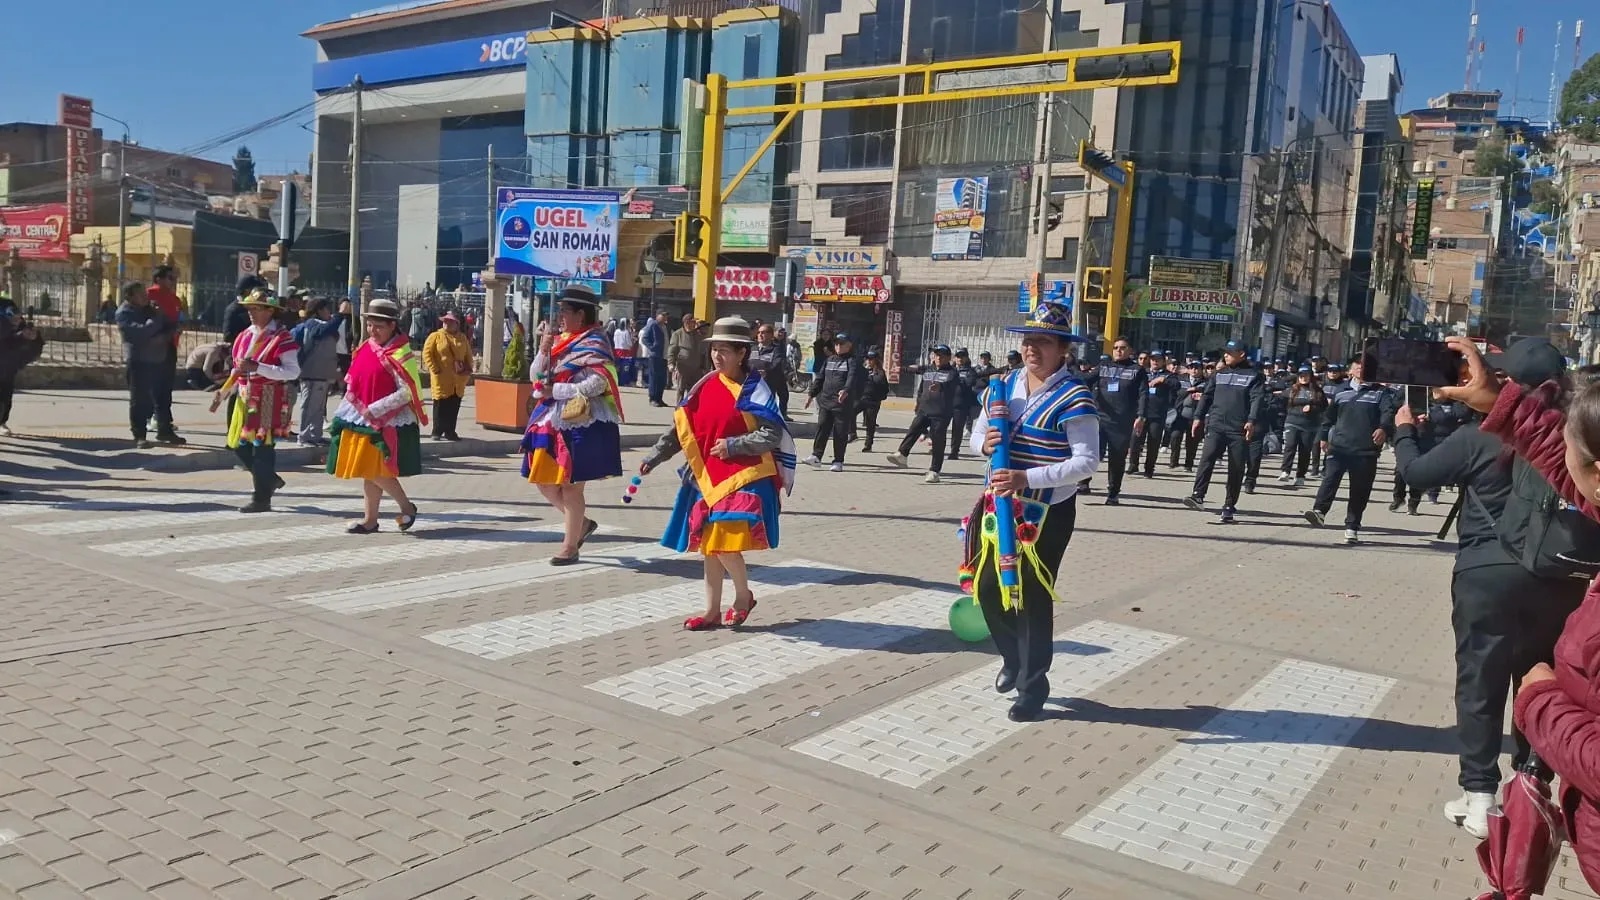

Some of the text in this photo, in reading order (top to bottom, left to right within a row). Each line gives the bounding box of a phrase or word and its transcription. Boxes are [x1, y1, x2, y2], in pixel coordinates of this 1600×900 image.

[489, 37, 526, 62] BCP
[535, 207, 587, 228] UGEL
[0, 224, 57, 237] PTICA CENTRAL
[533, 227, 611, 251] SAN ROMÁN
[815, 251, 872, 263] VISION
[713, 284, 773, 299] LADOS
[837, 288, 876, 296] CATALINA
[1150, 287, 1242, 308] LIBRERIA
[1151, 310, 1177, 318] COPIAS
[1182, 312, 1228, 320] IMPRESIONES
[892, 312, 902, 372] BOTICA
